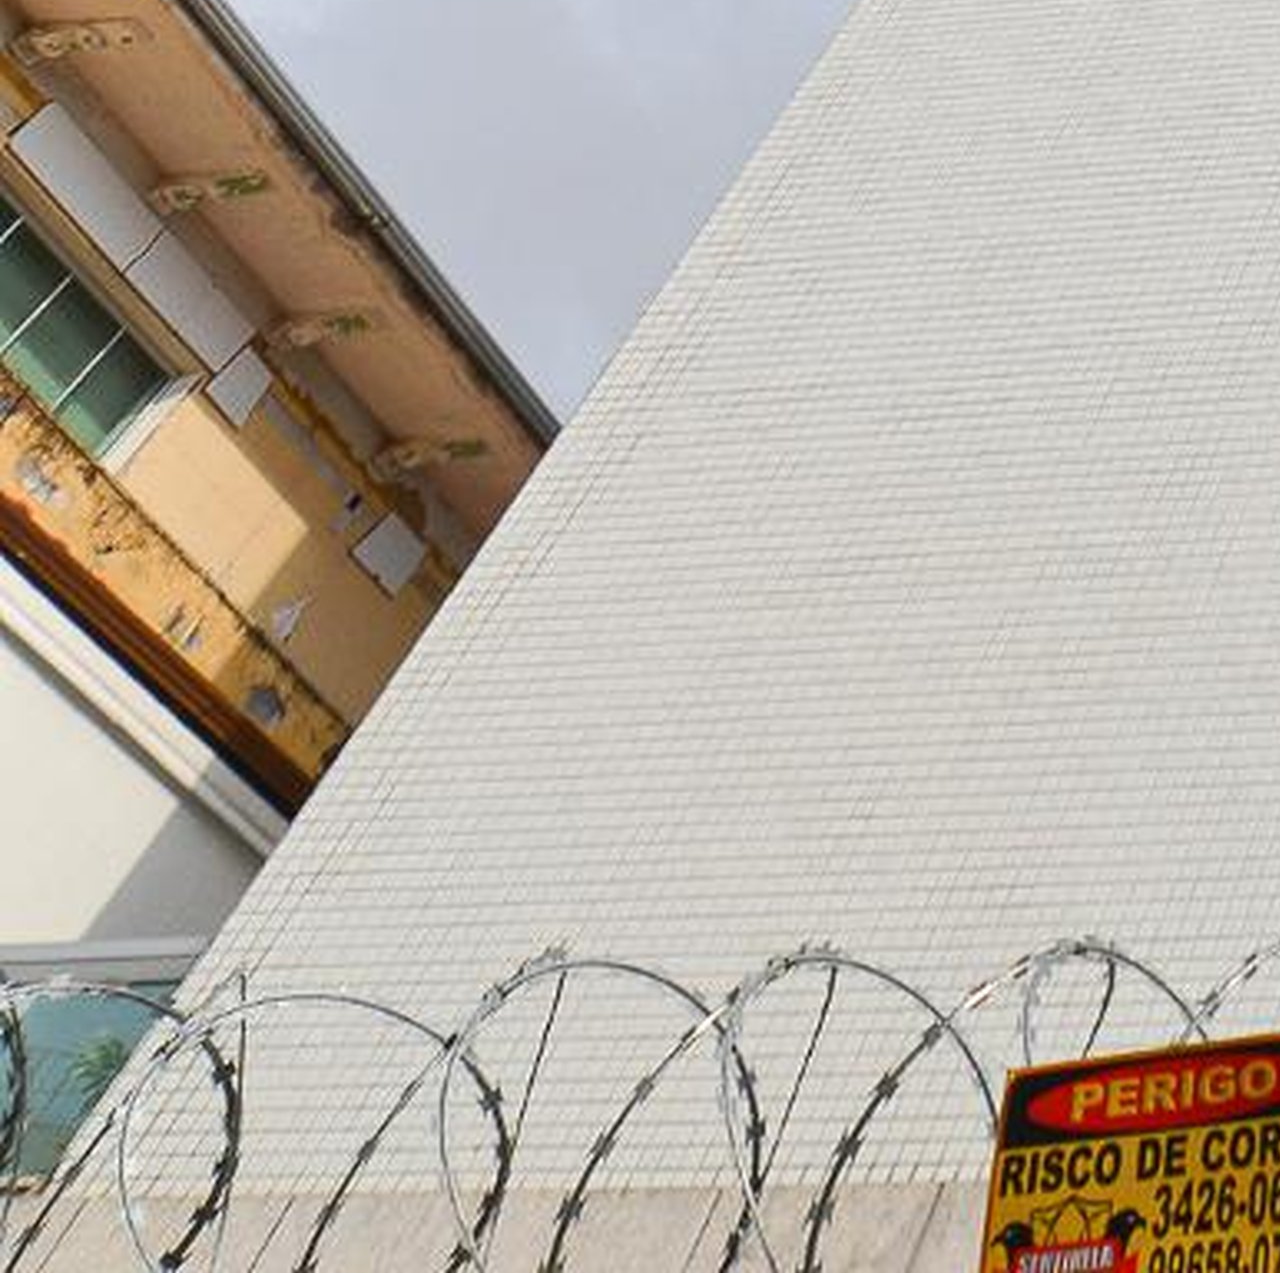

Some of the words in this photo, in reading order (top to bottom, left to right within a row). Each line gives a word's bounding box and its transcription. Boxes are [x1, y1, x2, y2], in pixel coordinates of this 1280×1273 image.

[1069, 1059, 1278, 1124] PERIGO
[1000, 1144, 1122, 1197] RISCO
[1136, 1135, 1188, 1181] DE
